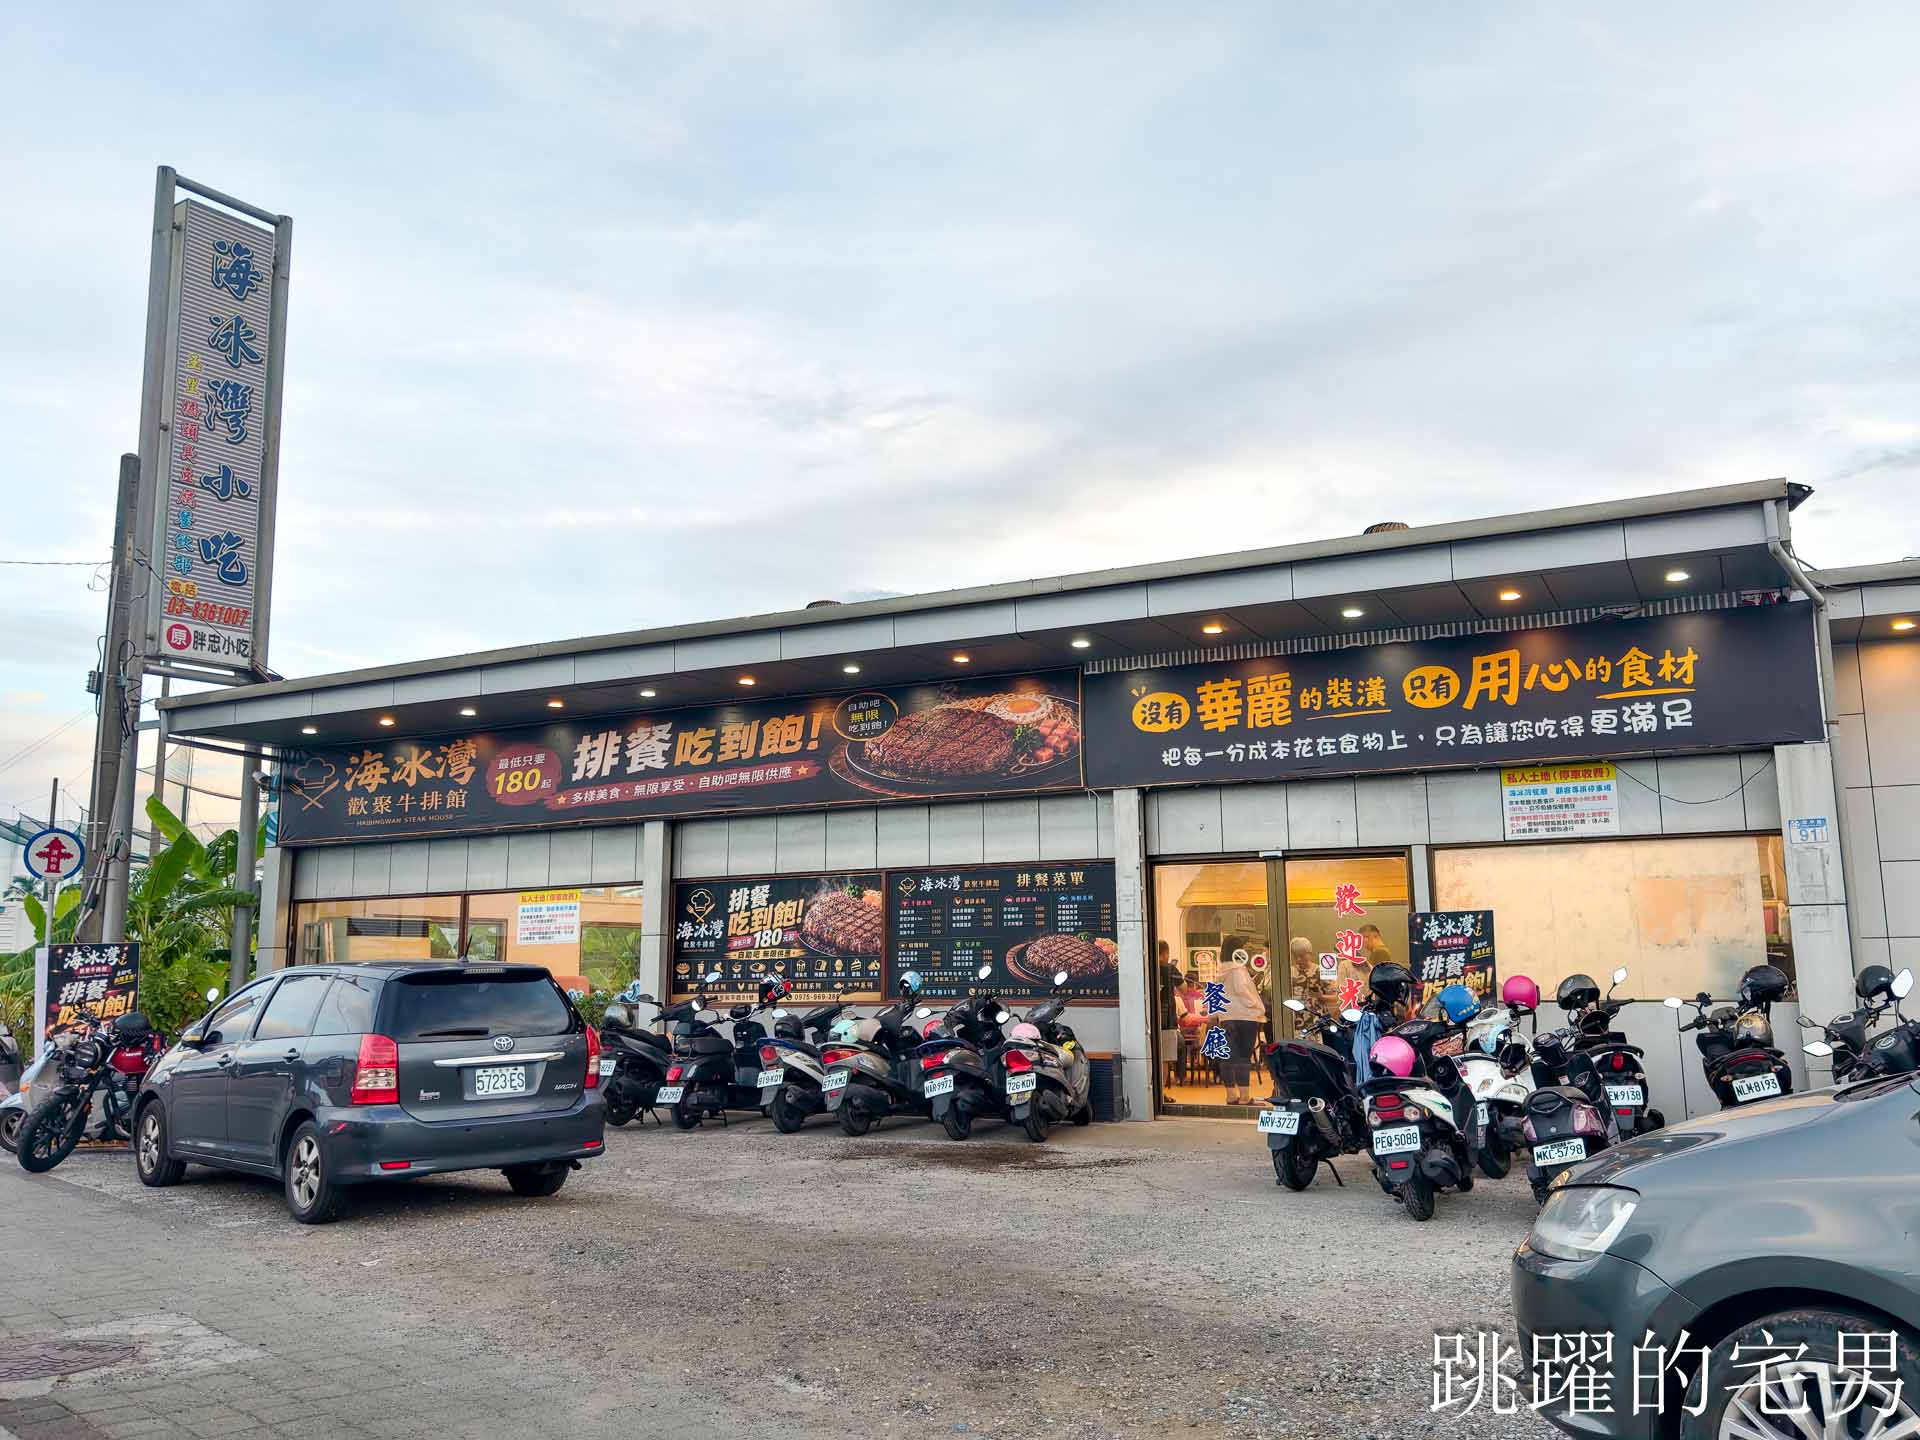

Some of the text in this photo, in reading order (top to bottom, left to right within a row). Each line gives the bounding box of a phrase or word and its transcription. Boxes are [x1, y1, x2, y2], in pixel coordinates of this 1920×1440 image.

[199, 239, 263, 585] 海冰灣小吃
[193, 631, 249, 657] 胖忠小吃
[848, 699, 881, 712] 自助吧
[850, 711, 880, 723] 無限
[344, 739, 479, 793] 海冰灣
[498, 752, 546, 770] 最低只要
[348, 789, 468, 817] 歡聚牛排館
[403, 815, 426, 823] STEAK
[920, 875, 961, 893] 海冰灣
[1016, 871, 1085, 888] 排餐菜單
[728, 884, 771, 913] 排餐
[676, 919, 725, 940] 海冰灣
[1422, 914, 1475, 941] 海冰灣
[64, 946, 120, 969] 海冰灣
[1421, 952, 1466, 981] 排餐
[58, 979, 108, 1005] 排餐
[1201, 982, 1232, 1060] 餐廳
[1608, 1090, 1642, 1101] EW-9138
[1259, 1115, 1297, 1129] NRV-3727
